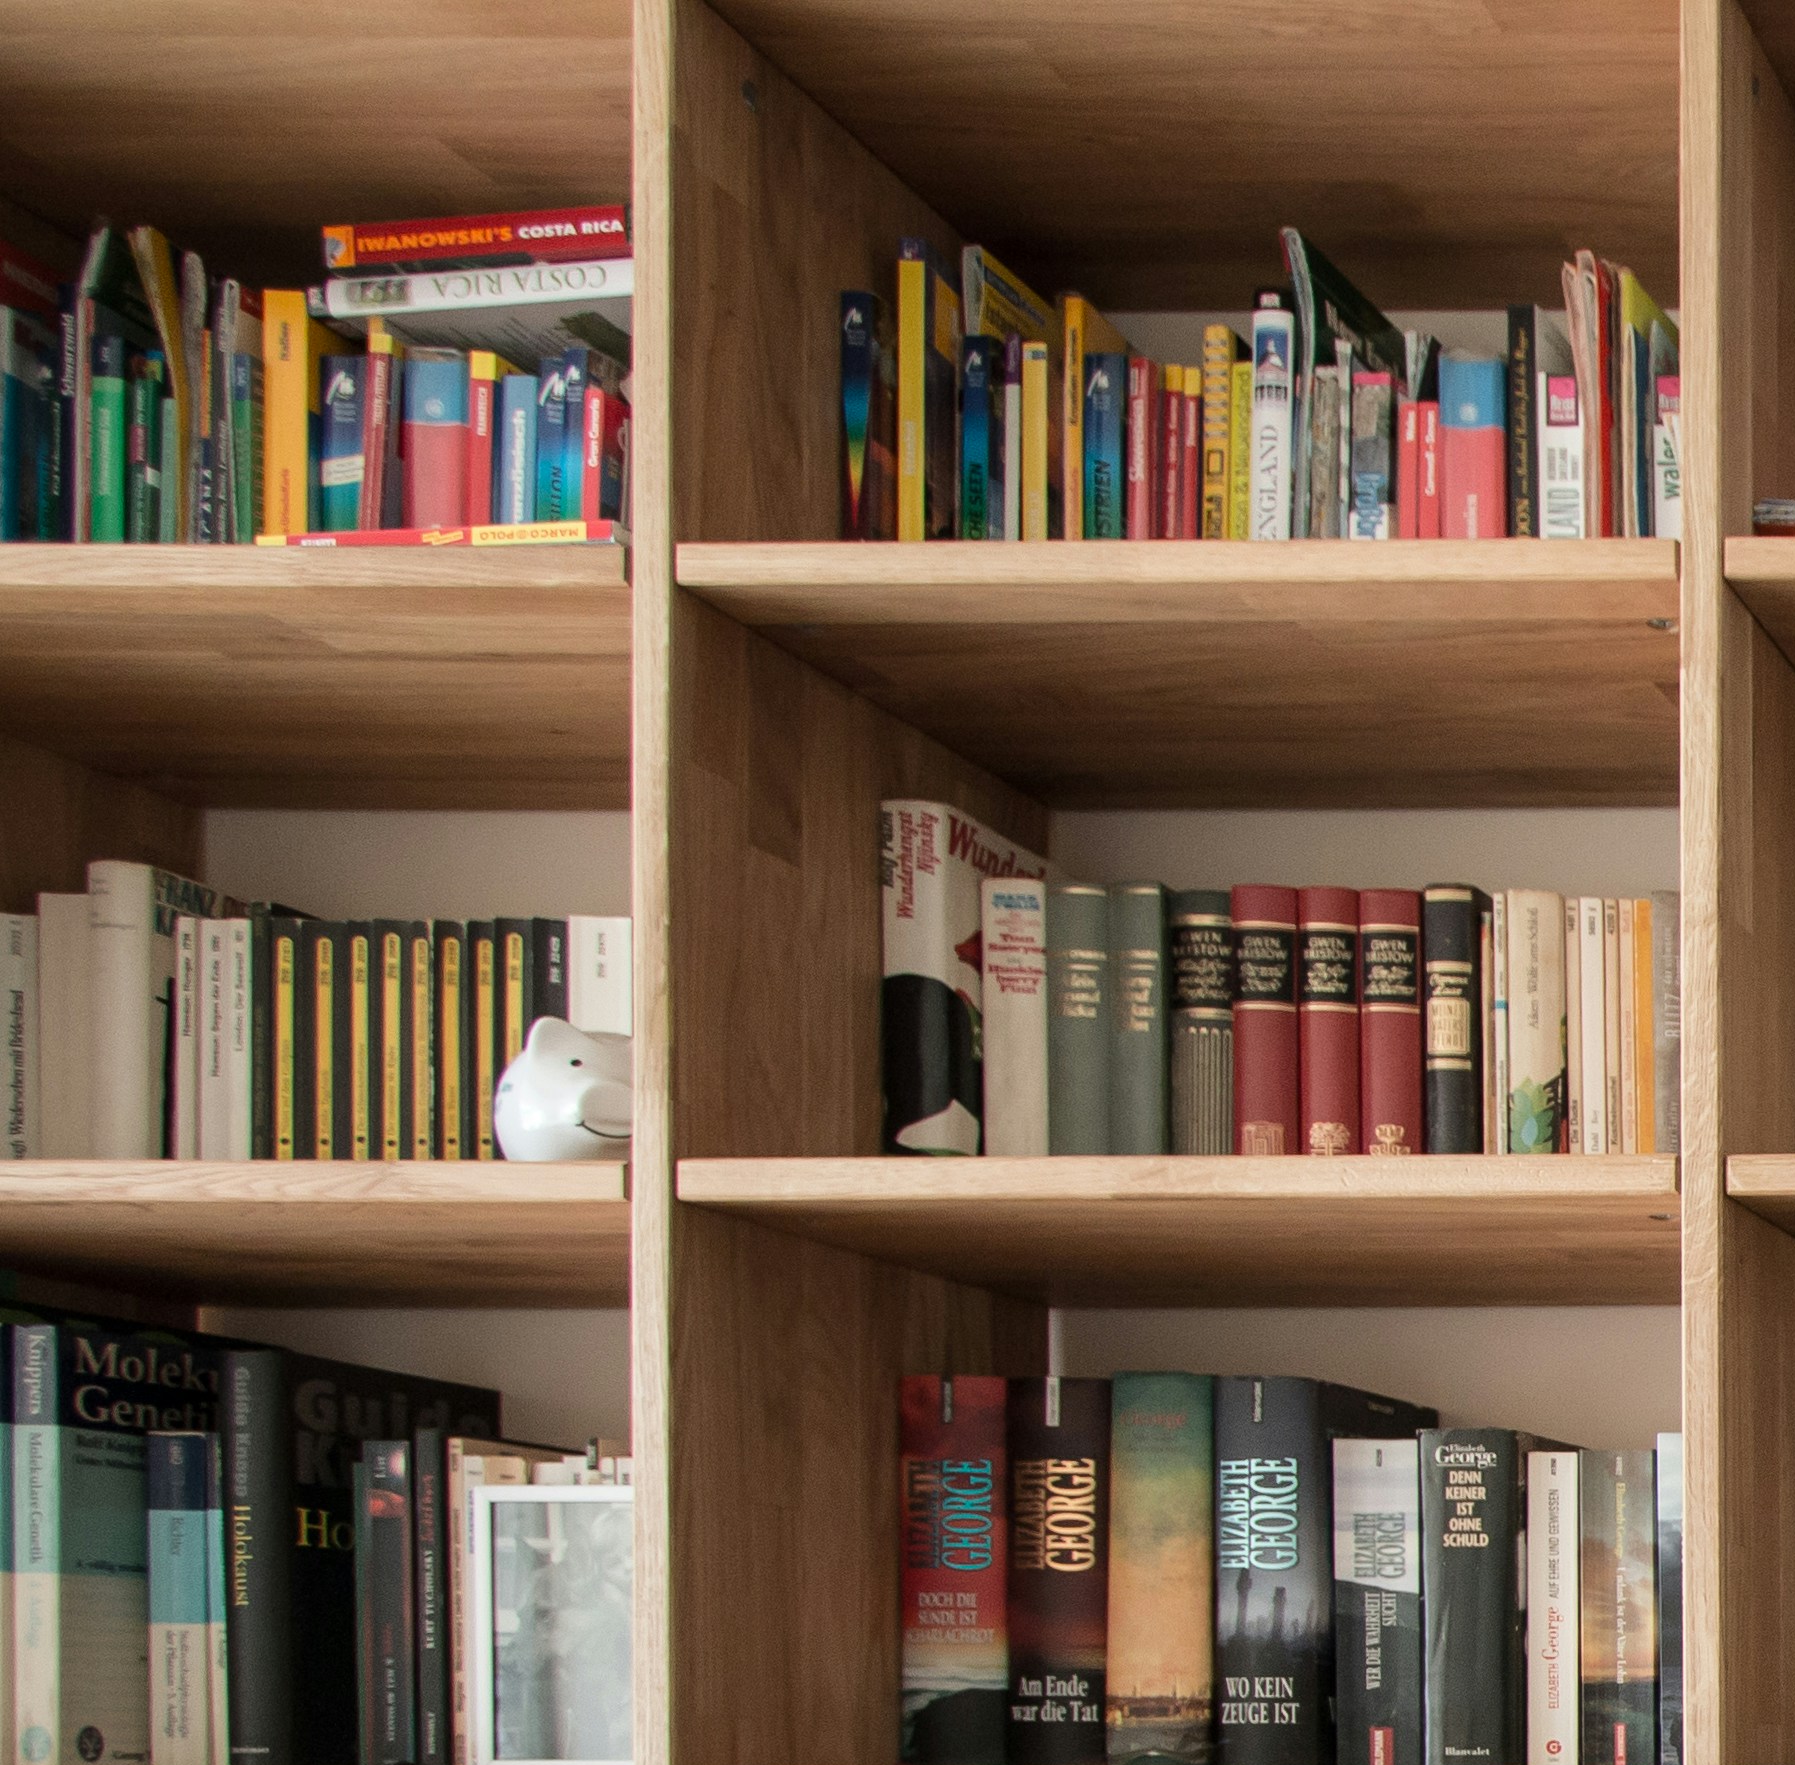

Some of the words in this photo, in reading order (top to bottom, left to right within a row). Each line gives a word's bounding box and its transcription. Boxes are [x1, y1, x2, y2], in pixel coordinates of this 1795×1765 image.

[358, 228, 512, 252] IWANOWSKI'S
[518, 223, 576, 239] COSTA
[582, 219, 624, 234] RICA
[434, 270, 496, 295] RICA
[515, 265, 606, 291] COSTA
[480, 532, 514, 540] POLO
[530, 529, 579, 539] MARCO
[894, 810, 912, 917] Wunderhengst
[913, 806, 934, 875] Nijinsky
[233, 1506, 251, 1606] Holokaust
[942, 1458, 993, 1571] GEORGE
[1015, 1459, 1045, 1569] ELIZABETH
[1046, 1458, 1096, 1572] GEORGE
[1220, 1459, 1249, 1569] ELIZABETH
[1251, 1457, 1298, 1571] GEORGE
